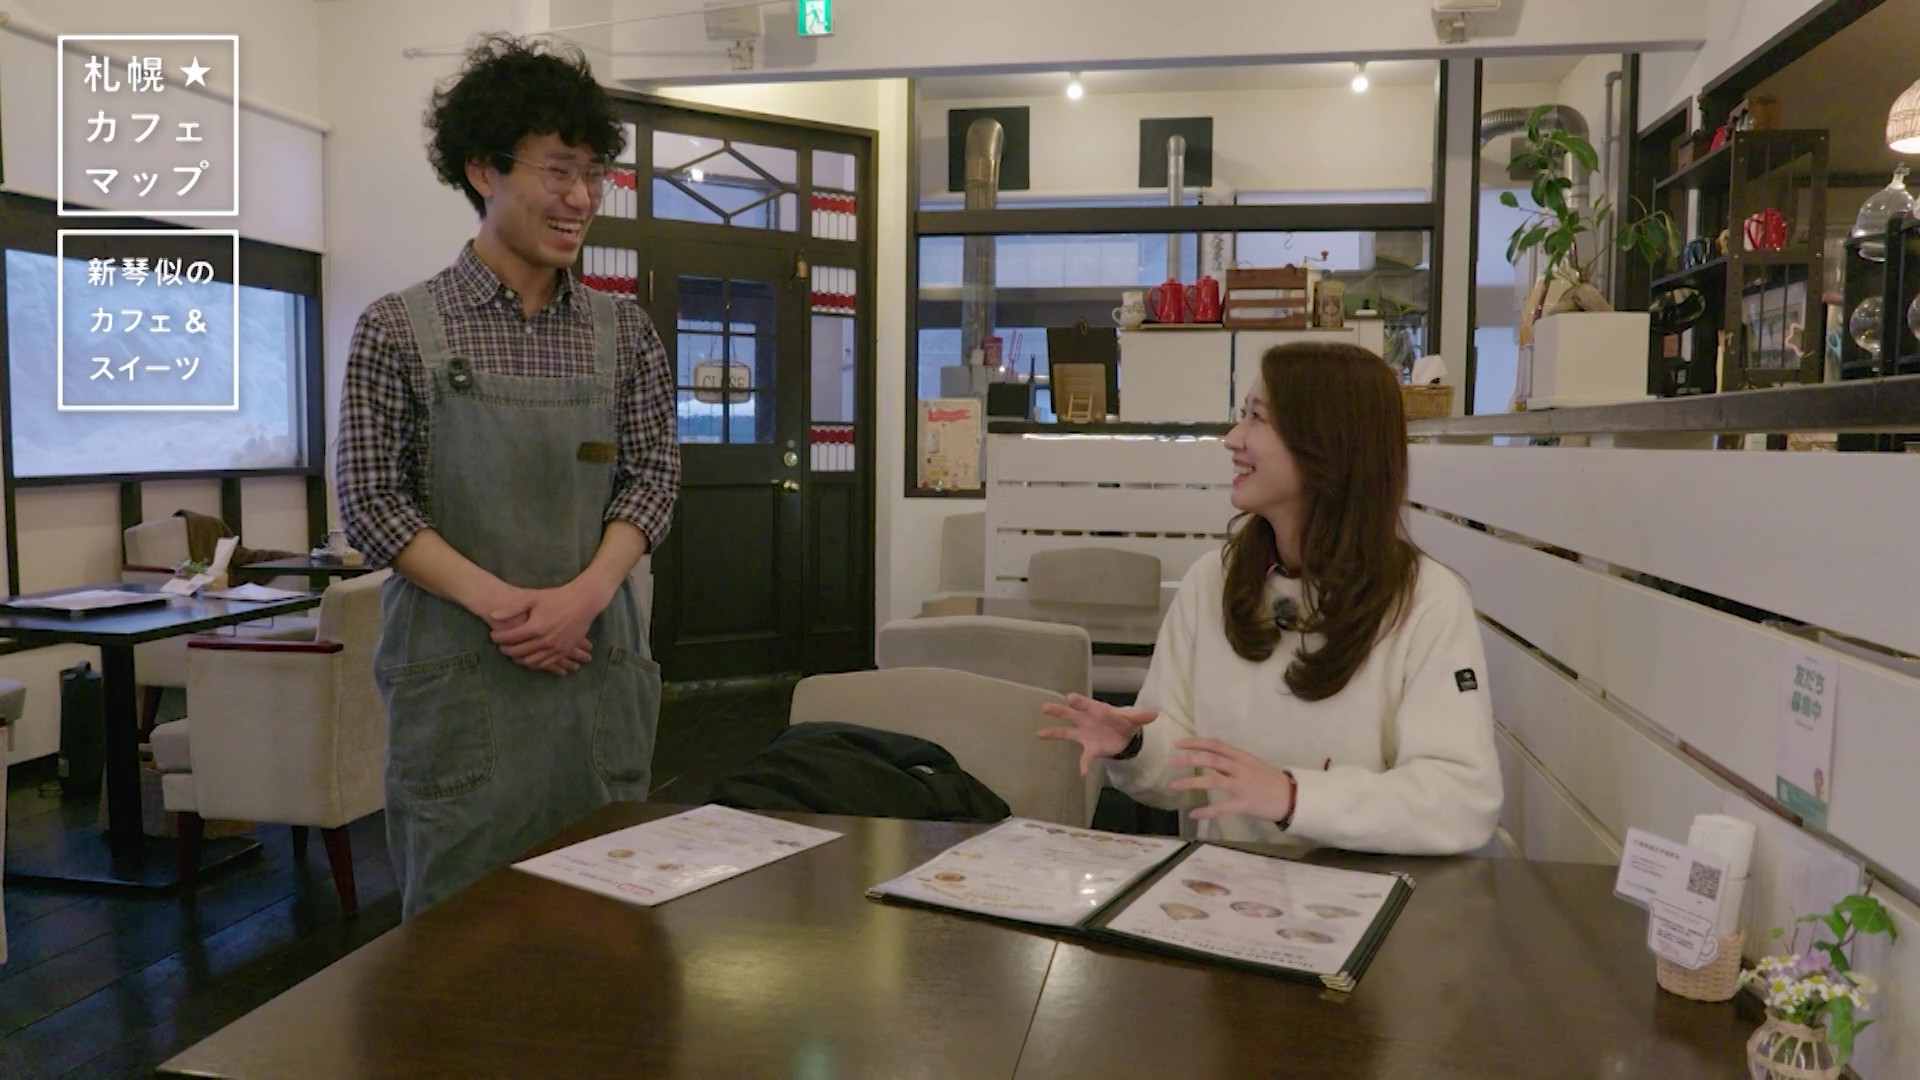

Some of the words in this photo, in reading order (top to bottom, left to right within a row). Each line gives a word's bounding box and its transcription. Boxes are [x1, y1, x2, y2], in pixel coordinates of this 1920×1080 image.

[702, 375, 745, 394] CLSE
[1794, 664, 1825, 696] 友だち
